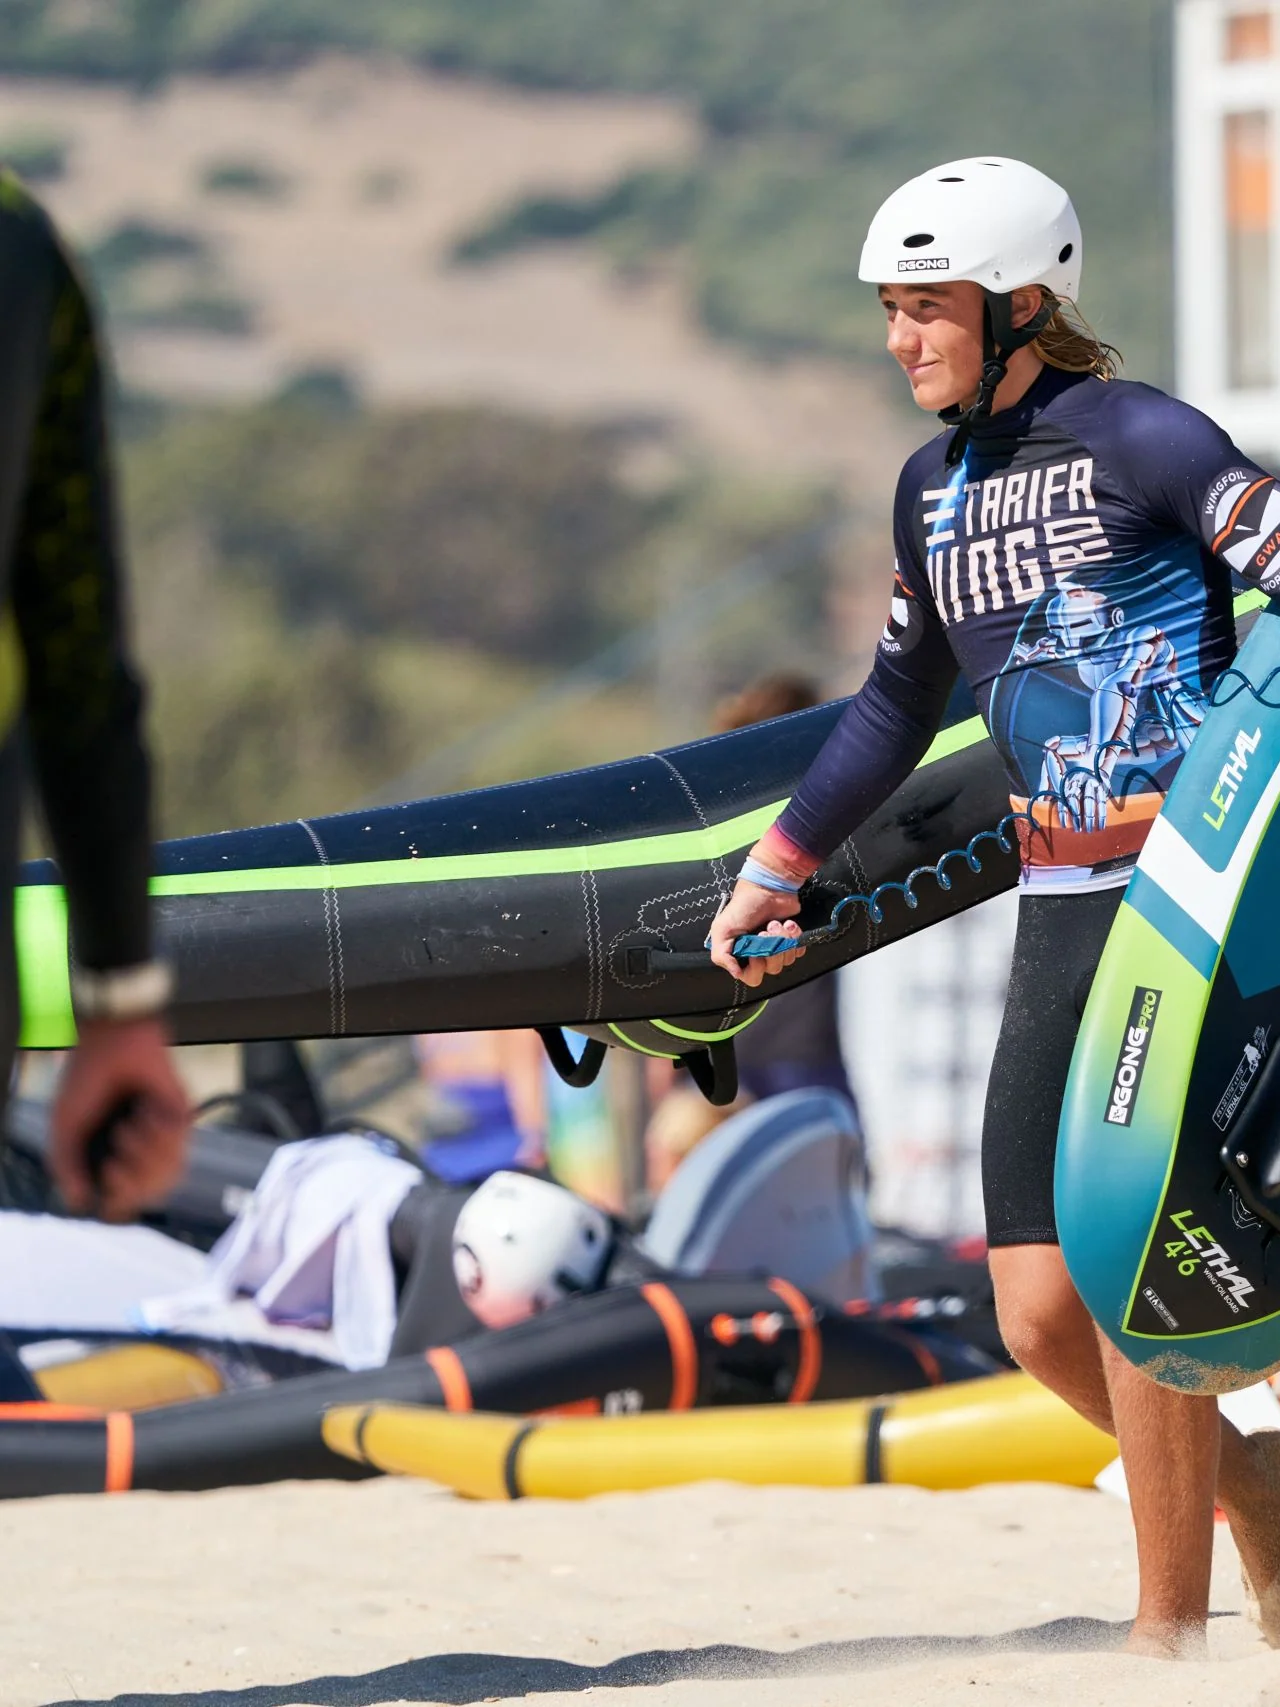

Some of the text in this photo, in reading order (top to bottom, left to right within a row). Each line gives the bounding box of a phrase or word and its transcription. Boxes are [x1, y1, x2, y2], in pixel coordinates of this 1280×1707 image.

[907, 258, 949, 270] GONG
[964, 458, 1096, 536] TARIFA
[1205, 470, 1247, 515] WINGFOIL
[1202, 727, 1262, 831] LETHAL
[1113, 990, 1157, 1108] GONG PRO
[1225, 1095, 1240, 1119] LETHAL
[1163, 1241, 1202, 1276] 4'6
[1169, 1209, 1256, 1308] LETHAL
[1203, 1267, 1240, 1314] WING FOIL BOARD
